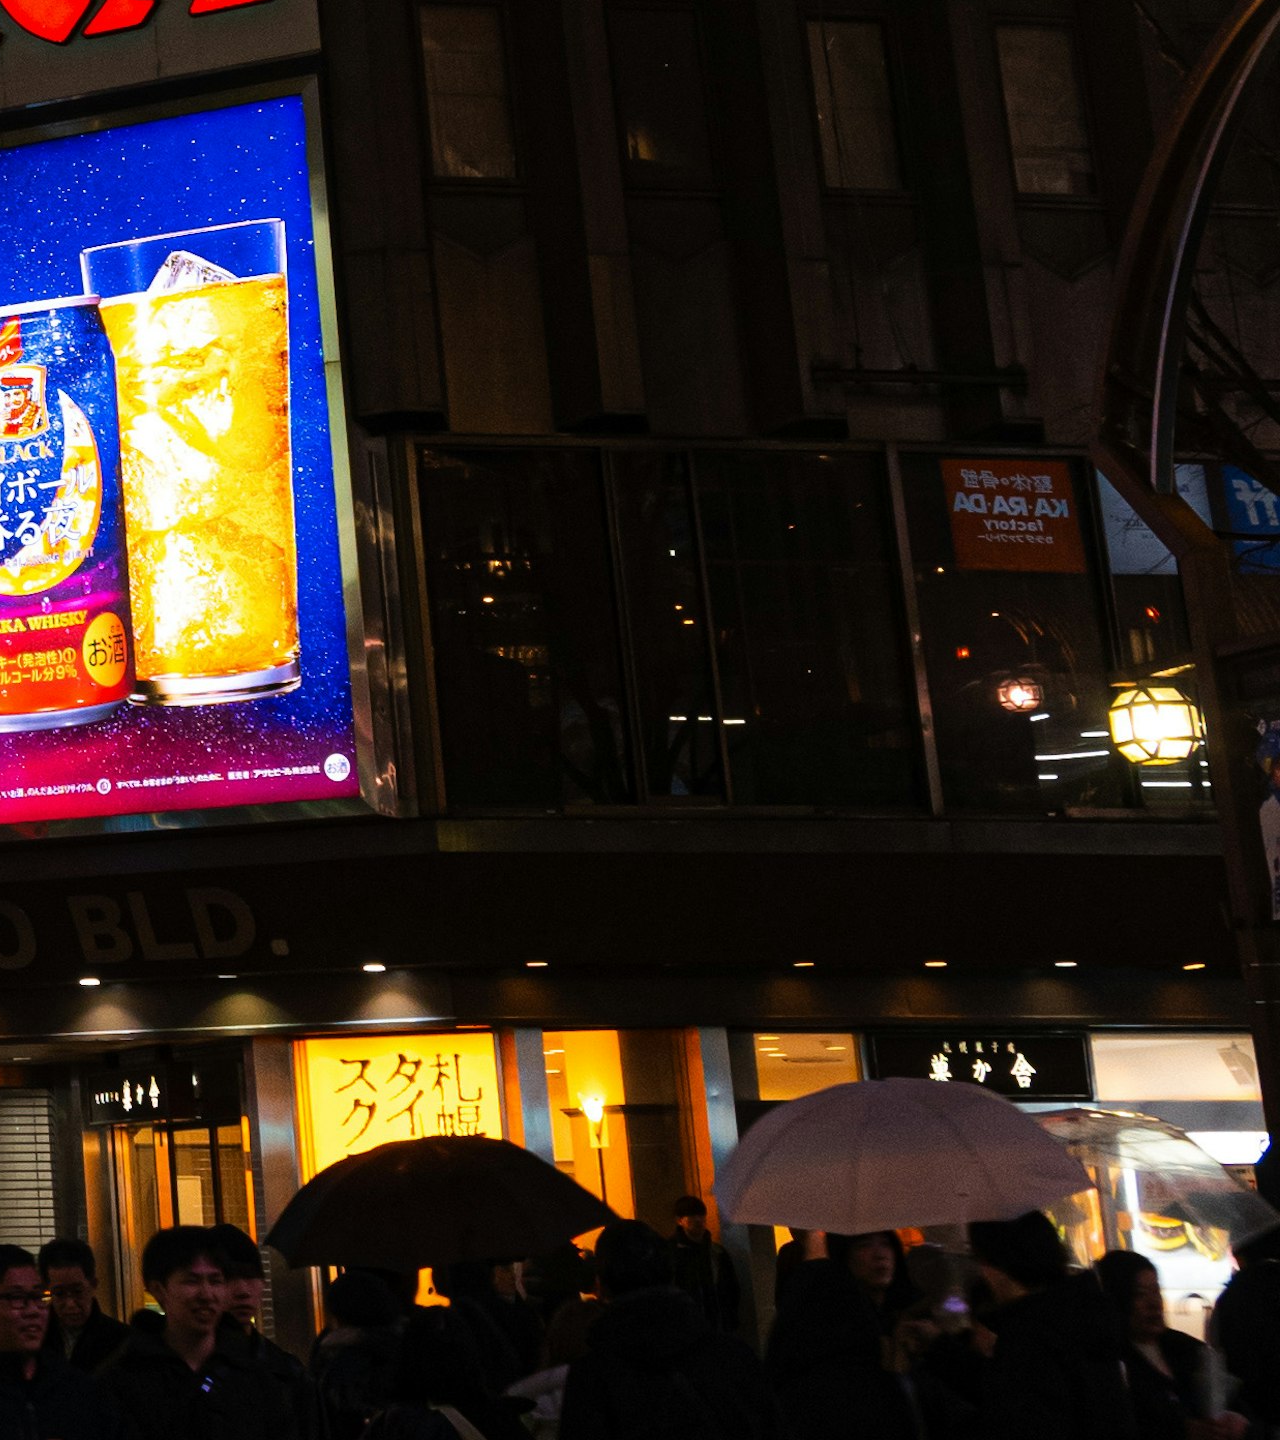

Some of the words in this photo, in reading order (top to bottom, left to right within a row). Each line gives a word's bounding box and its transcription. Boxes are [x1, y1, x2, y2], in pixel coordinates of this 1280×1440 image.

[27, 610, 89, 631] WHISKY
[87, 630, 126, 668] お酒
[66, 886, 291, 967] BLD.
